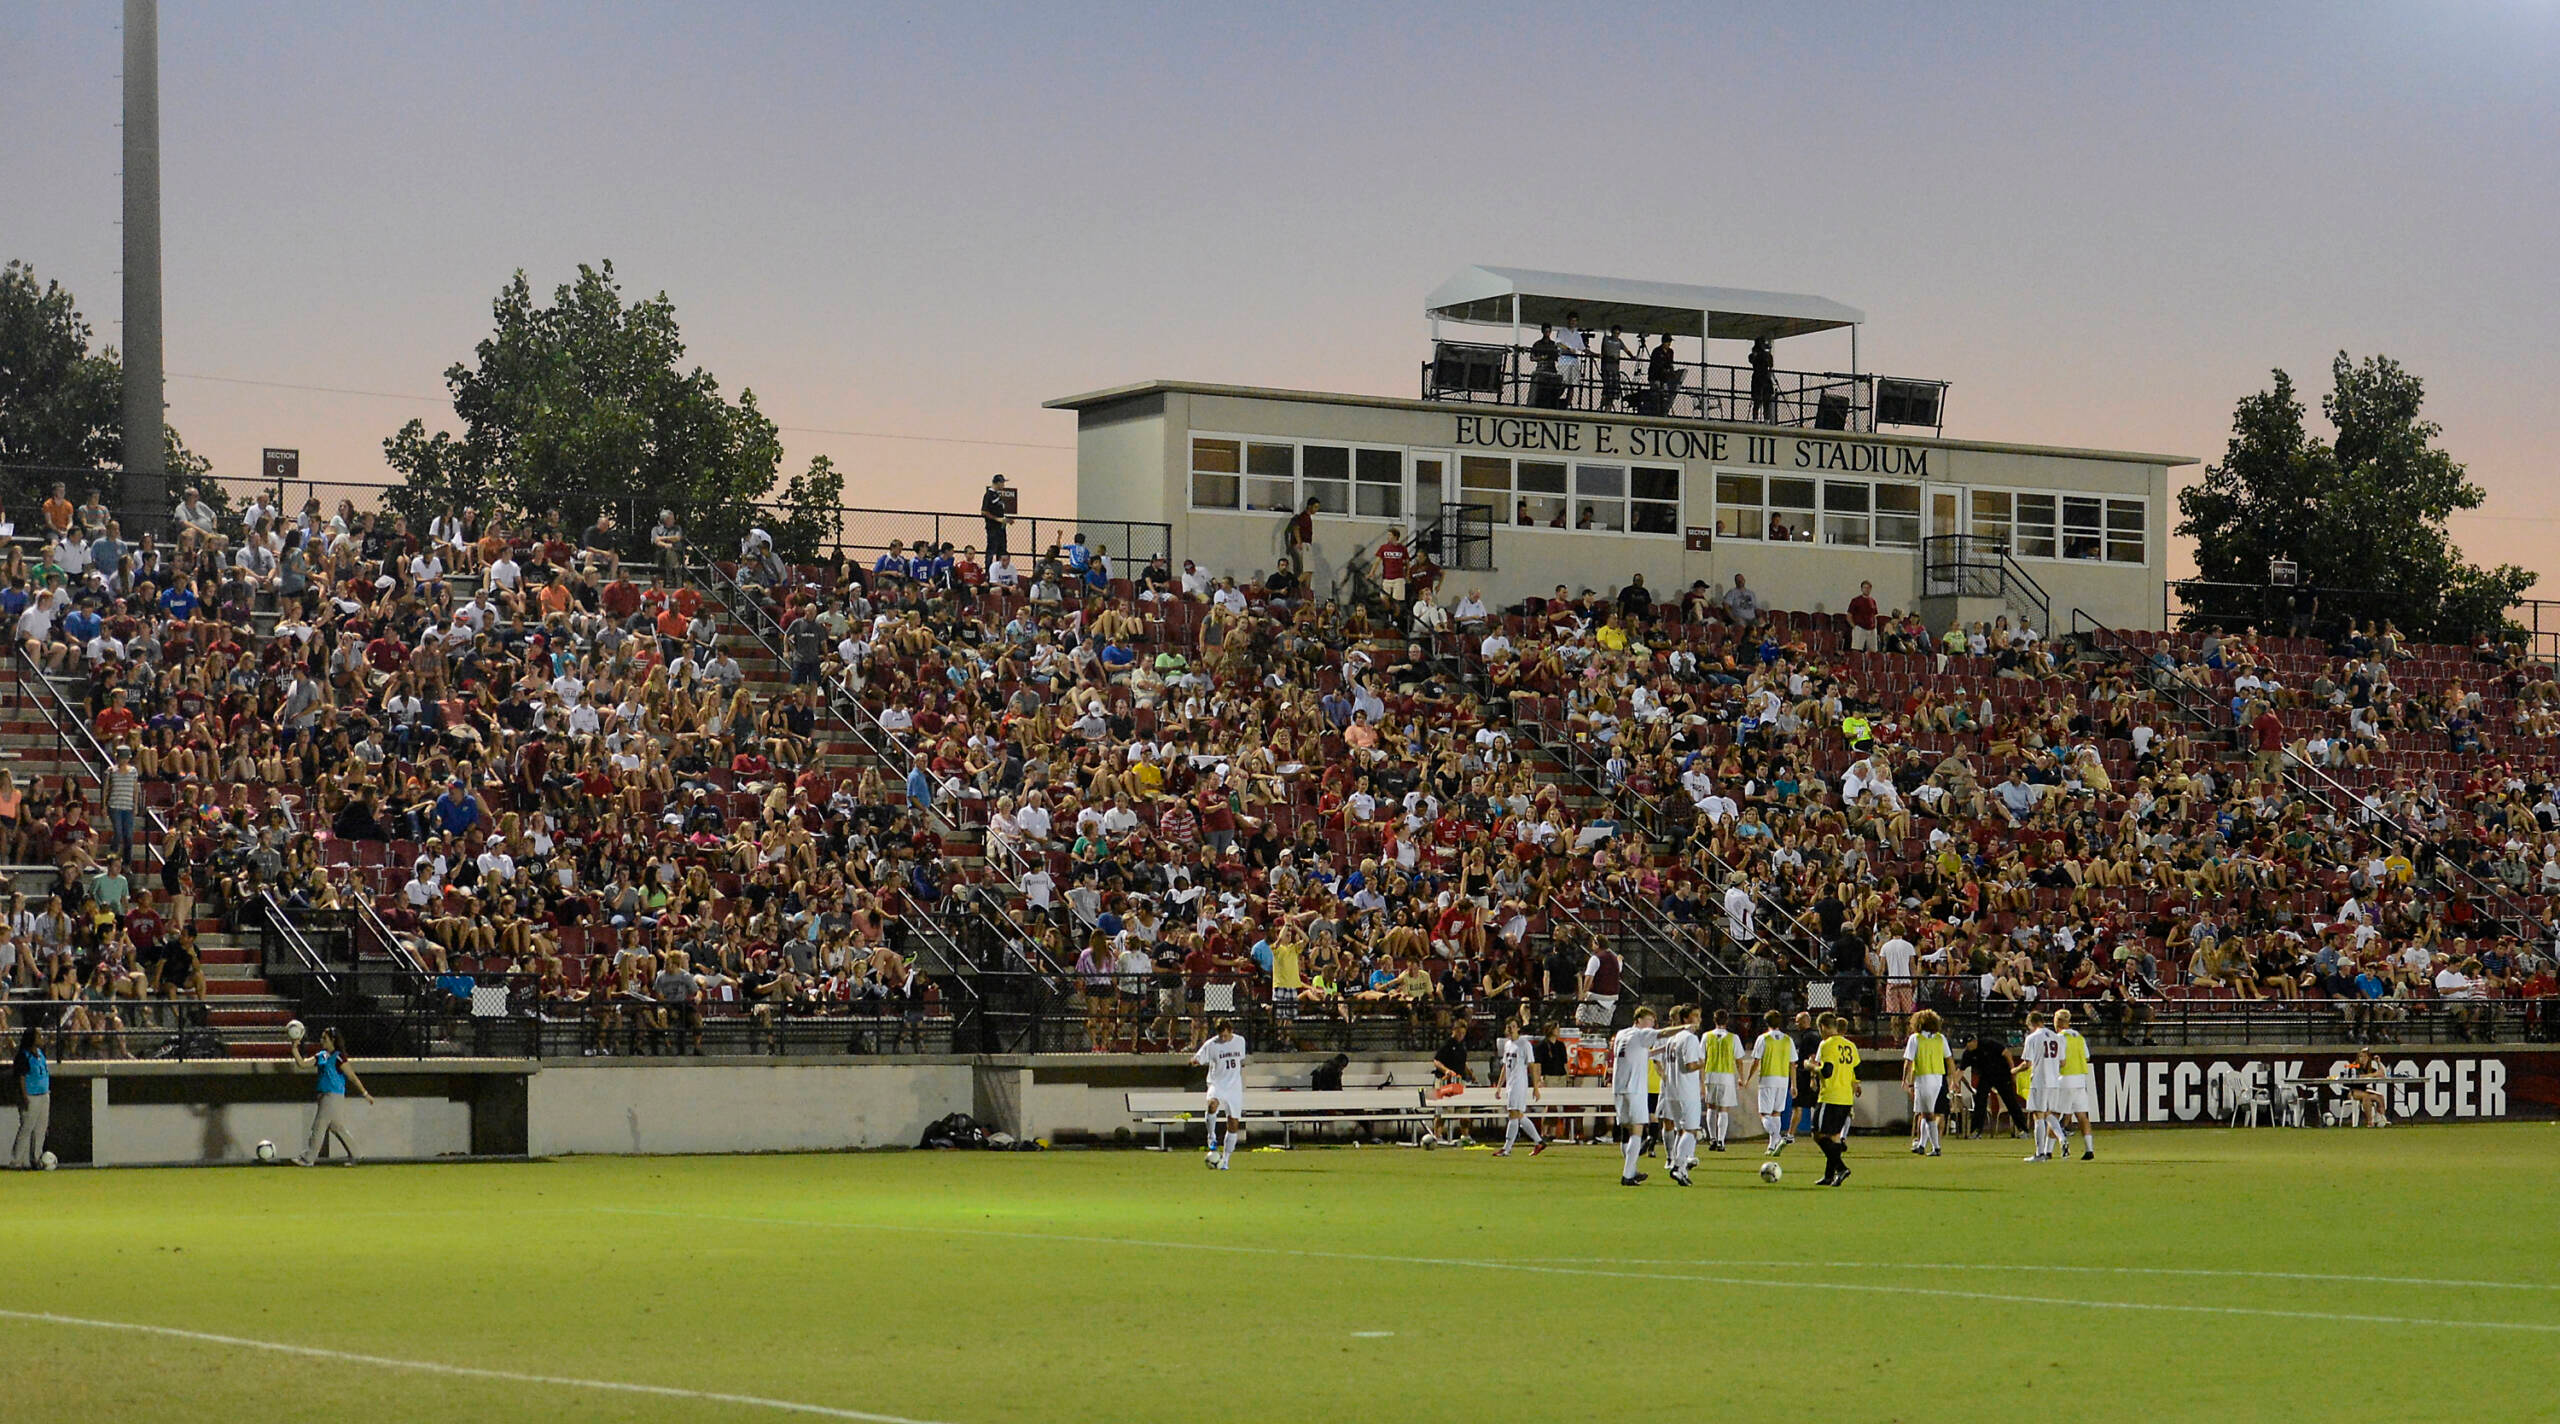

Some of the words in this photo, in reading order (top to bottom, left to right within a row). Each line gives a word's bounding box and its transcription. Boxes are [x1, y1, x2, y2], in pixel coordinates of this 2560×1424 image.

[1455, 415, 1581, 451] EUGENE
[1595, 425, 1619, 454] E.
[1629, 427, 1729, 461] STONE
[1747, 436, 1776, 465] III
[1794, 439, 1928, 476] STADIUM
[266, 451, 296, 461] SECTION
[277, 464, 285, 473] C
[1837, 1044, 1853, 1065] 33
[2043, 1040, 2058, 1058] 19
[1226, 1059, 1237, 1070] 16
